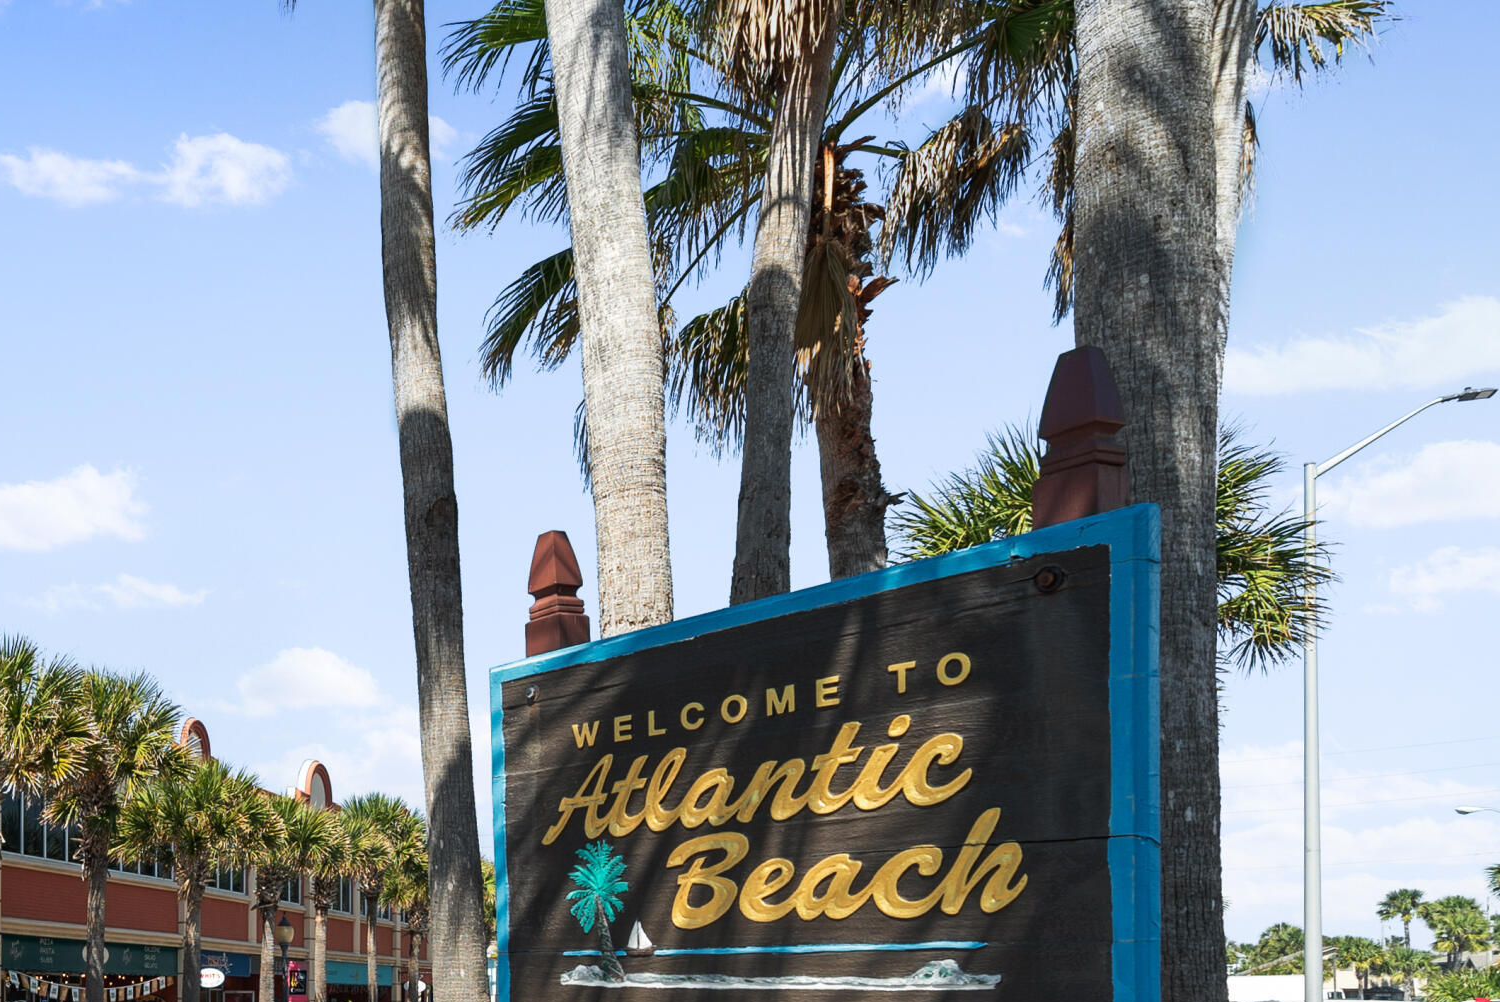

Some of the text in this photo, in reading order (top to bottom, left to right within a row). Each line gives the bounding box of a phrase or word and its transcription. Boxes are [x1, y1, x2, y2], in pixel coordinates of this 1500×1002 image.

[571, 651, 973, 749] WELCOME TO
[541, 713, 974, 846] Atlantic
[665, 806, 1029, 930] Beach
